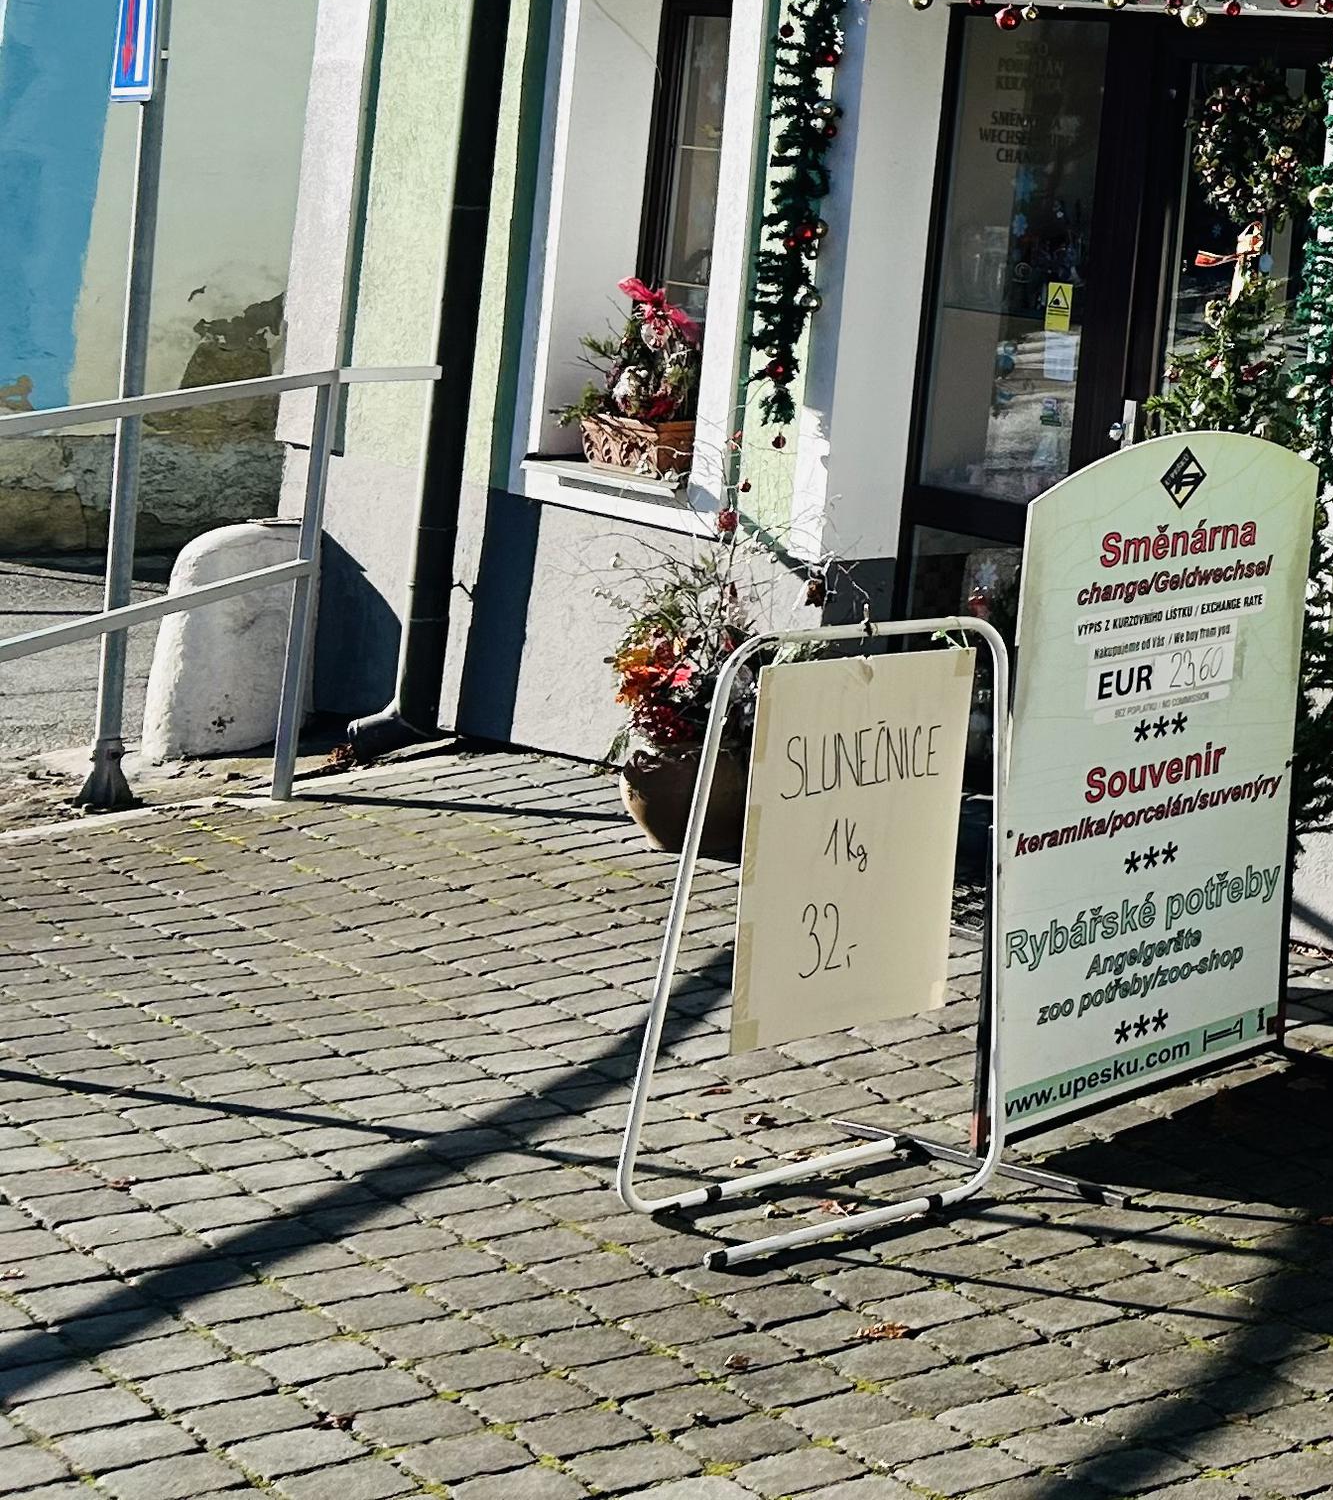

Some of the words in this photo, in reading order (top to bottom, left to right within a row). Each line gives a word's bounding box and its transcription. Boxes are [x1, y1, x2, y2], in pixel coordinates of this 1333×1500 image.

[1099, 519, 1257, 568] Směnárna
[1077, 555, 1274, 606] change/Geldwechsel
[1077, 620, 1103, 637] VÝPIS
[1104, 619, 1111, 632] Z
[1112, 608, 1163, 630] KURZOVNÍHO
[1165, 605, 1194, 621] LÍSTKU
[1200, 597, 1242, 615] EXCHANGE
[1243, 593, 1264, 608] RATE
[1094, 640, 1141, 660] Nakupujeme
[1141, 637, 1152, 651] od
[1152, 635, 1166, 649] Vás
[1174, 631, 1185, 645] We
[1185, 629, 1199, 642] buy
[1199, 626, 1217, 640] from
[1097, 664, 1153, 700] EUR
[1114, 707, 1127, 719] BEZ
[1162, 699, 1171, 709] NO
[1171, 691, 1210, 707] COMMISSION
[780, 719, 943, 801] SLUNEČNICE
[1084, 741, 1227, 804] Souvenir
[1014, 774, 1283, 858] keramika/porcelán/suvenýry
[1005, 891, 1157, 972] Rybářské
[1165, 865, 1282, 930] potřeby
[1086, 926, 1203, 980] Angelgeräte
[1037, 998, 1075, 1026] zoo
[1077, 946, 1245, 1018] potřeby/zoo-shop
